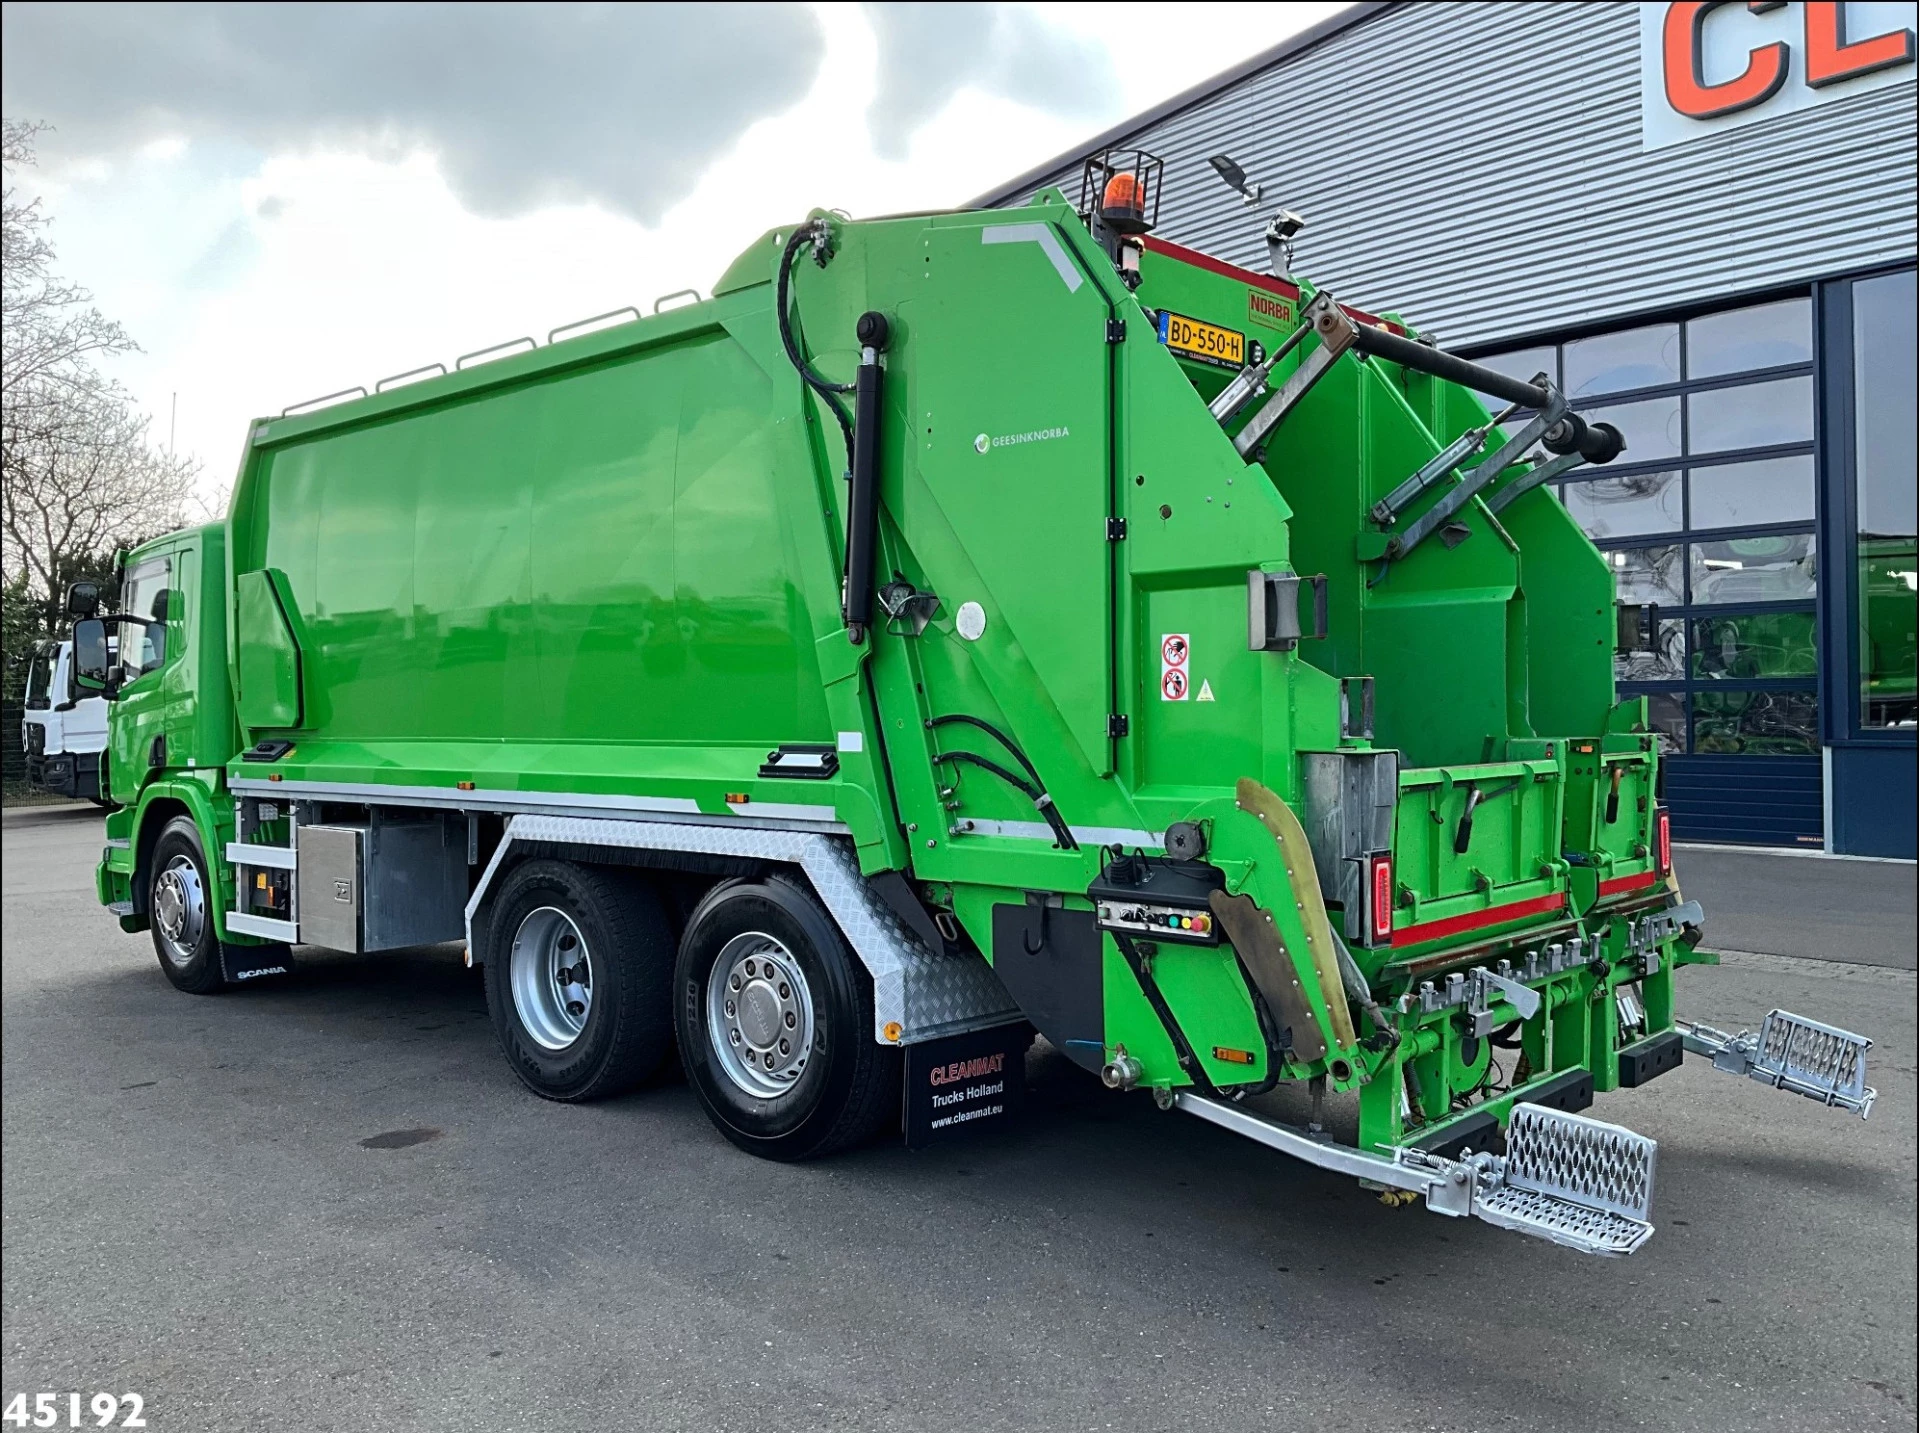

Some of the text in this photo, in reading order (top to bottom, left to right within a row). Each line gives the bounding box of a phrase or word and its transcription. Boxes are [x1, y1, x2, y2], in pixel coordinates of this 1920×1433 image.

[1663, 2, 1915, 120] CL
[1250, 293, 1290, 322] NORBA
[1171, 320, 1240, 358] BD-550-H
[992, 426, 1070, 447] GEESINKNORBA
[237, 966, 287, 979] SCANIA
[930, 1053, 1005, 1086] CLEANMAT
[932, 1080, 1004, 1108] Trucks Holland
[931, 1105, 1003, 1129] www.cleanmat.eu
